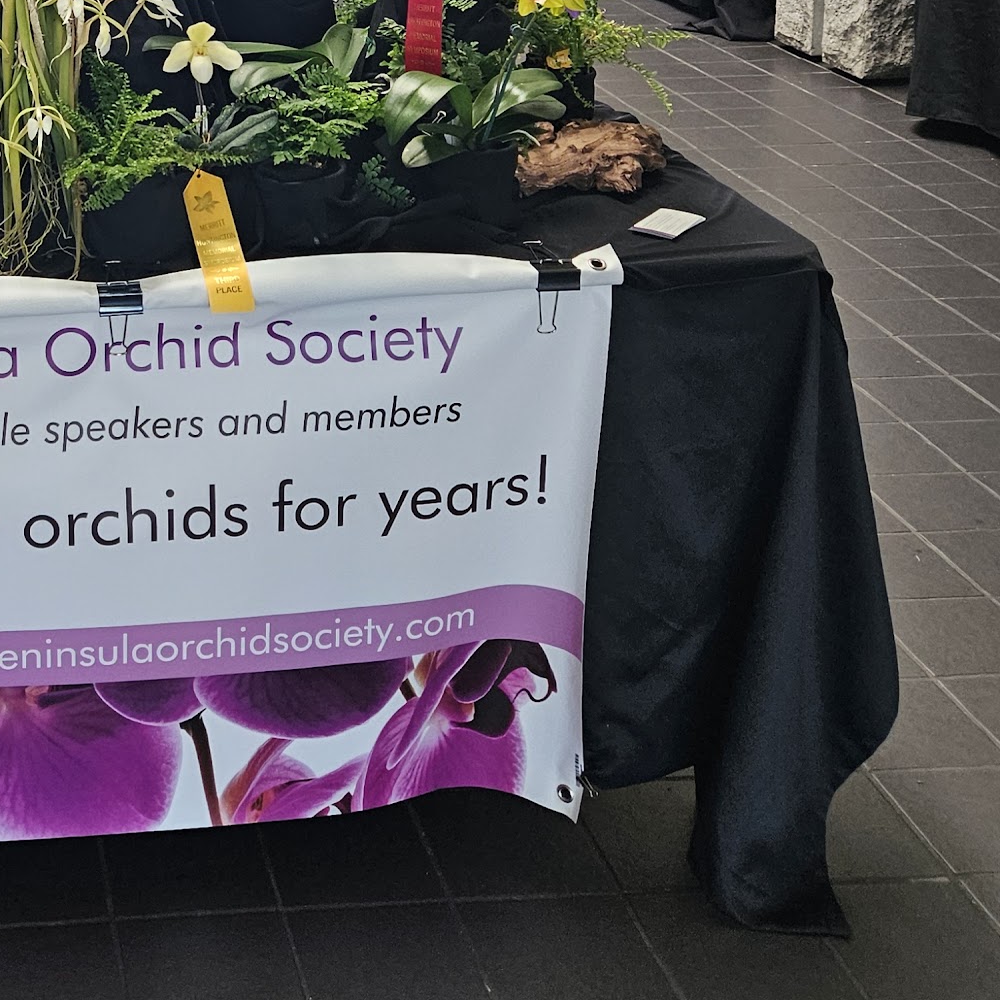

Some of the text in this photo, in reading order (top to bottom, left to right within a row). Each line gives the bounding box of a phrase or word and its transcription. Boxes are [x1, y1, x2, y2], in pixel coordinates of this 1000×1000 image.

[215, 286, 243, 294] PLACE
[45, 320, 240, 377] Orchid
[265, 314, 463, 374] Society
[43, 405, 204, 452] speakers
[218, 400, 287, 436] and
[301, 395, 462, 432] members
[23, 483, 249, 549] orchids
[272, 478, 357, 532] for
[378, 454, 548, 537] years!
